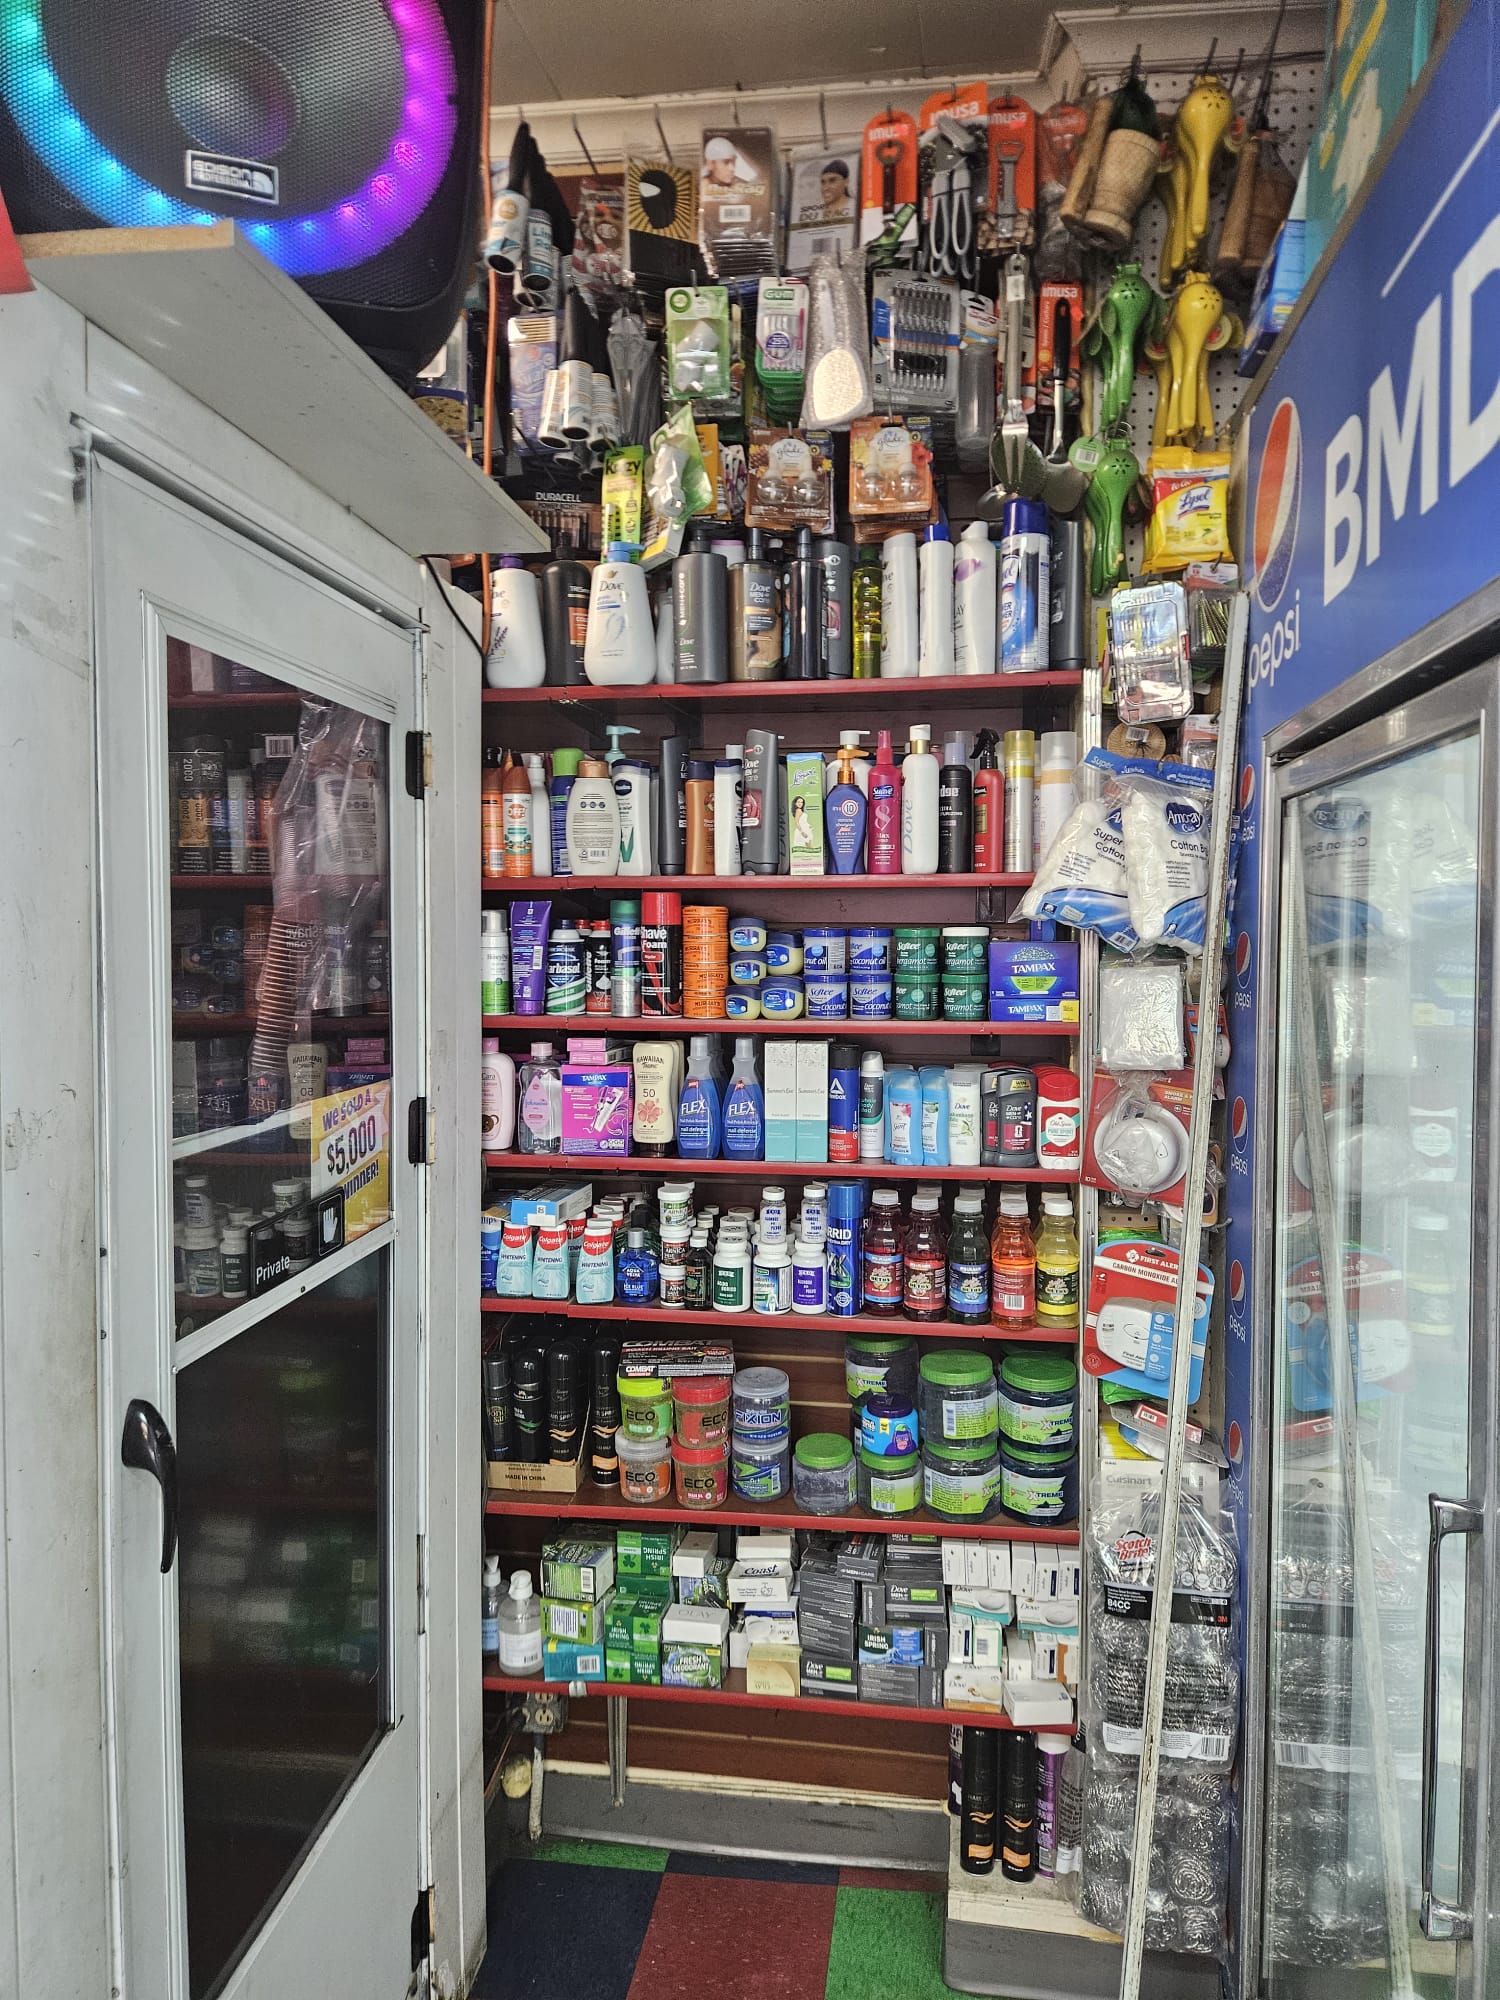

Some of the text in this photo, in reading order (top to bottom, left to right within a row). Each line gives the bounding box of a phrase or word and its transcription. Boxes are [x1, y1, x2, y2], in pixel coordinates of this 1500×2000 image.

[764, 287, 795, 301] GUM
[1043, 285, 1079, 298] imusa
[535, 491, 581, 503] DURACELL
[1179, 486, 1211, 513] Lysol
[1248, 588, 1300, 702] pepsi
[1092, 754, 1114, 769] Super
[872, 786, 894, 796] Suave
[940, 784, 961, 797] dge
[1168, 809, 1202, 828] Amoray
[903, 799, 913, 855] Dove
[1093, 827, 1123, 846] Super
[1095, 841, 1125, 860] Cotton
[1170, 839, 1199, 852] Cotton
[642, 941, 667, 949] Foam
[897, 942, 921, 950] Softee
[945, 942, 968, 950] Softee
[548, 962, 580, 975] arbasol
[1011, 961, 1057, 974] TAMPAX
[809, 987, 834, 996] Softee
[852, 987, 877, 996] Softee
[944, 987, 967, 996] Softee
[1234, 991, 1252, 1009] pepsi
[1008, 1003, 1045, 1014] TAMPAX
[581, 1074, 607, 1082] TAMPAX
[643, 1088, 656, 1098] 50
[340, 1095, 364, 1122] SOLD
[364, 1088, 372, 1105] A
[681, 1099, 706, 1115] FLEX
[728, 1101, 755, 1116] FLEX
[327, 1114, 377, 1176] $5,000
[1231, 1153, 1248, 1176] pepsi
[502, 1232, 527, 1242] Colgate
[538, 1235, 563, 1243] Colgate
[827, 1226, 852, 1240] RRID
[583, 1240, 609, 1249] Colgate
[537, 1256, 563, 1264] WHITENING
[581, 1262, 609, 1270] WHITENING
[1140, 1255, 1179, 1271] FIRST ALER
[255, 1254, 291, 1285] Private
[1112, 1261, 1136, 1275] CARBON
[1137, 1266, 1169, 1283] MONOXIDE
[1229, 1314, 1246, 1344] pepsi
[625, 1365, 655, 1373] COMBAT
[856, 1377, 888, 1388] XTREME
[626, 1407, 656, 1421] ECO
[702, 1410, 728, 1427] ECO
[735, 1409, 782, 1425] FIXION
[1039, 1417, 1073, 1431] XTREME
[529, 1474, 546, 1482] CHINA
[626, 1470, 656, 1482] ECO
[684, 1476, 715, 1489] ECO
[1105, 1474, 1152, 1487] Cuisinart
[1027, 1490, 1065, 1502] XTREME
[1115, 1536, 1153, 1551] Scotch
[1119, 1547, 1149, 1561] Brite
[744, 1564, 779, 1577] Coast
[890, 1585, 909, 1593] Dove
[1020, 1602, 1040, 1611] Dove
[1107, 1598, 1131, 1610] 84CC
[1217, 1615, 1228, 1623] 3M
[609, 1633, 630, 1641] SPRING
[867, 1634, 886, 1643] IRISH
[864, 1641, 889, 1650] SPRING
[679, 1655, 702, 1665] FRESH
[948, 1680, 967, 1688] Dove
